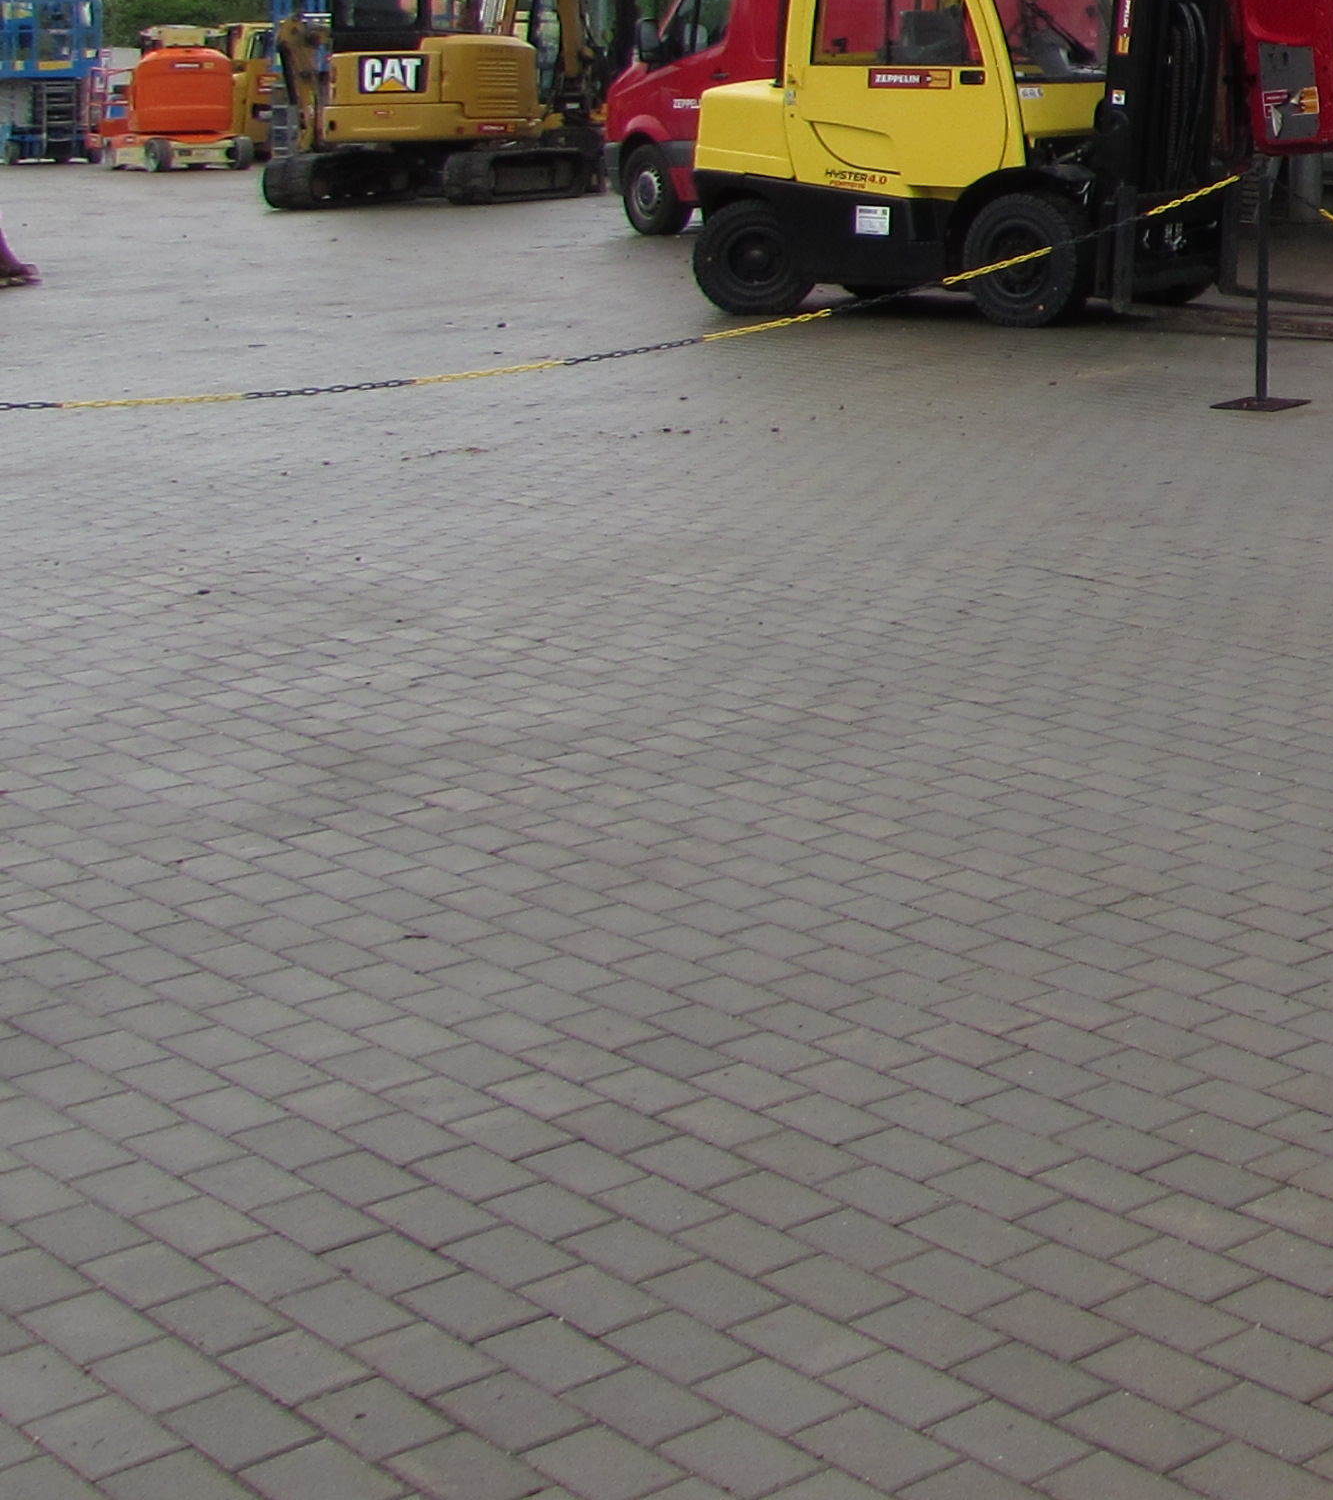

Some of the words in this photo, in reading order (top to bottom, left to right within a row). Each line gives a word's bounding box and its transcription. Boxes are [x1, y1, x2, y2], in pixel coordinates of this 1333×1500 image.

[363, 57, 422, 92] CAT
[875, 73, 921, 84] ZEPPELIN
[672, 98, 701, 109] ZEPPEL
[824, 169, 868, 183] HYSTER
[868, 174, 888, 185] 4.0
